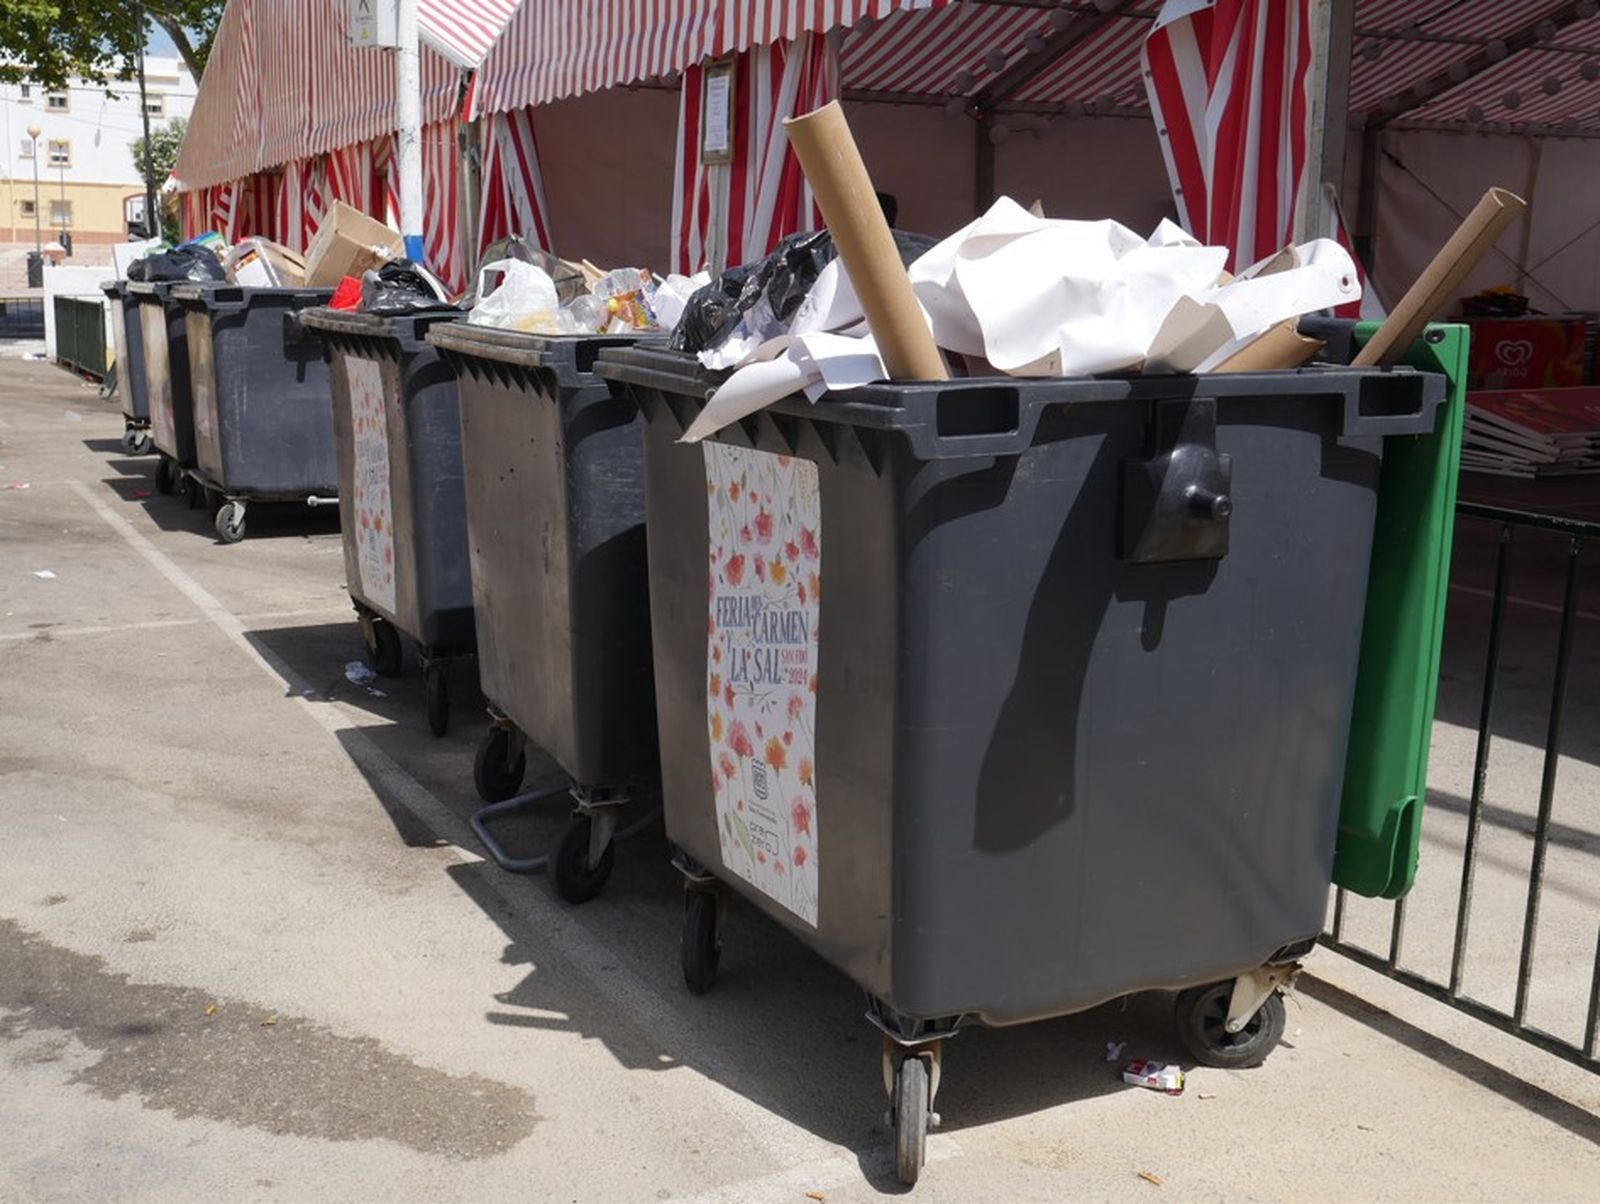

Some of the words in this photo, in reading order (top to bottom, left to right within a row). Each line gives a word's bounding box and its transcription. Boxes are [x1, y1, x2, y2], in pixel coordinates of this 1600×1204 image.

[717, 596, 751, 627] FERIA
[753, 610, 809, 644] CARMEN
[731, 647, 748, 682] LA
[753, 647, 782, 684] SAL
[788, 667, 808, 684] 2024
